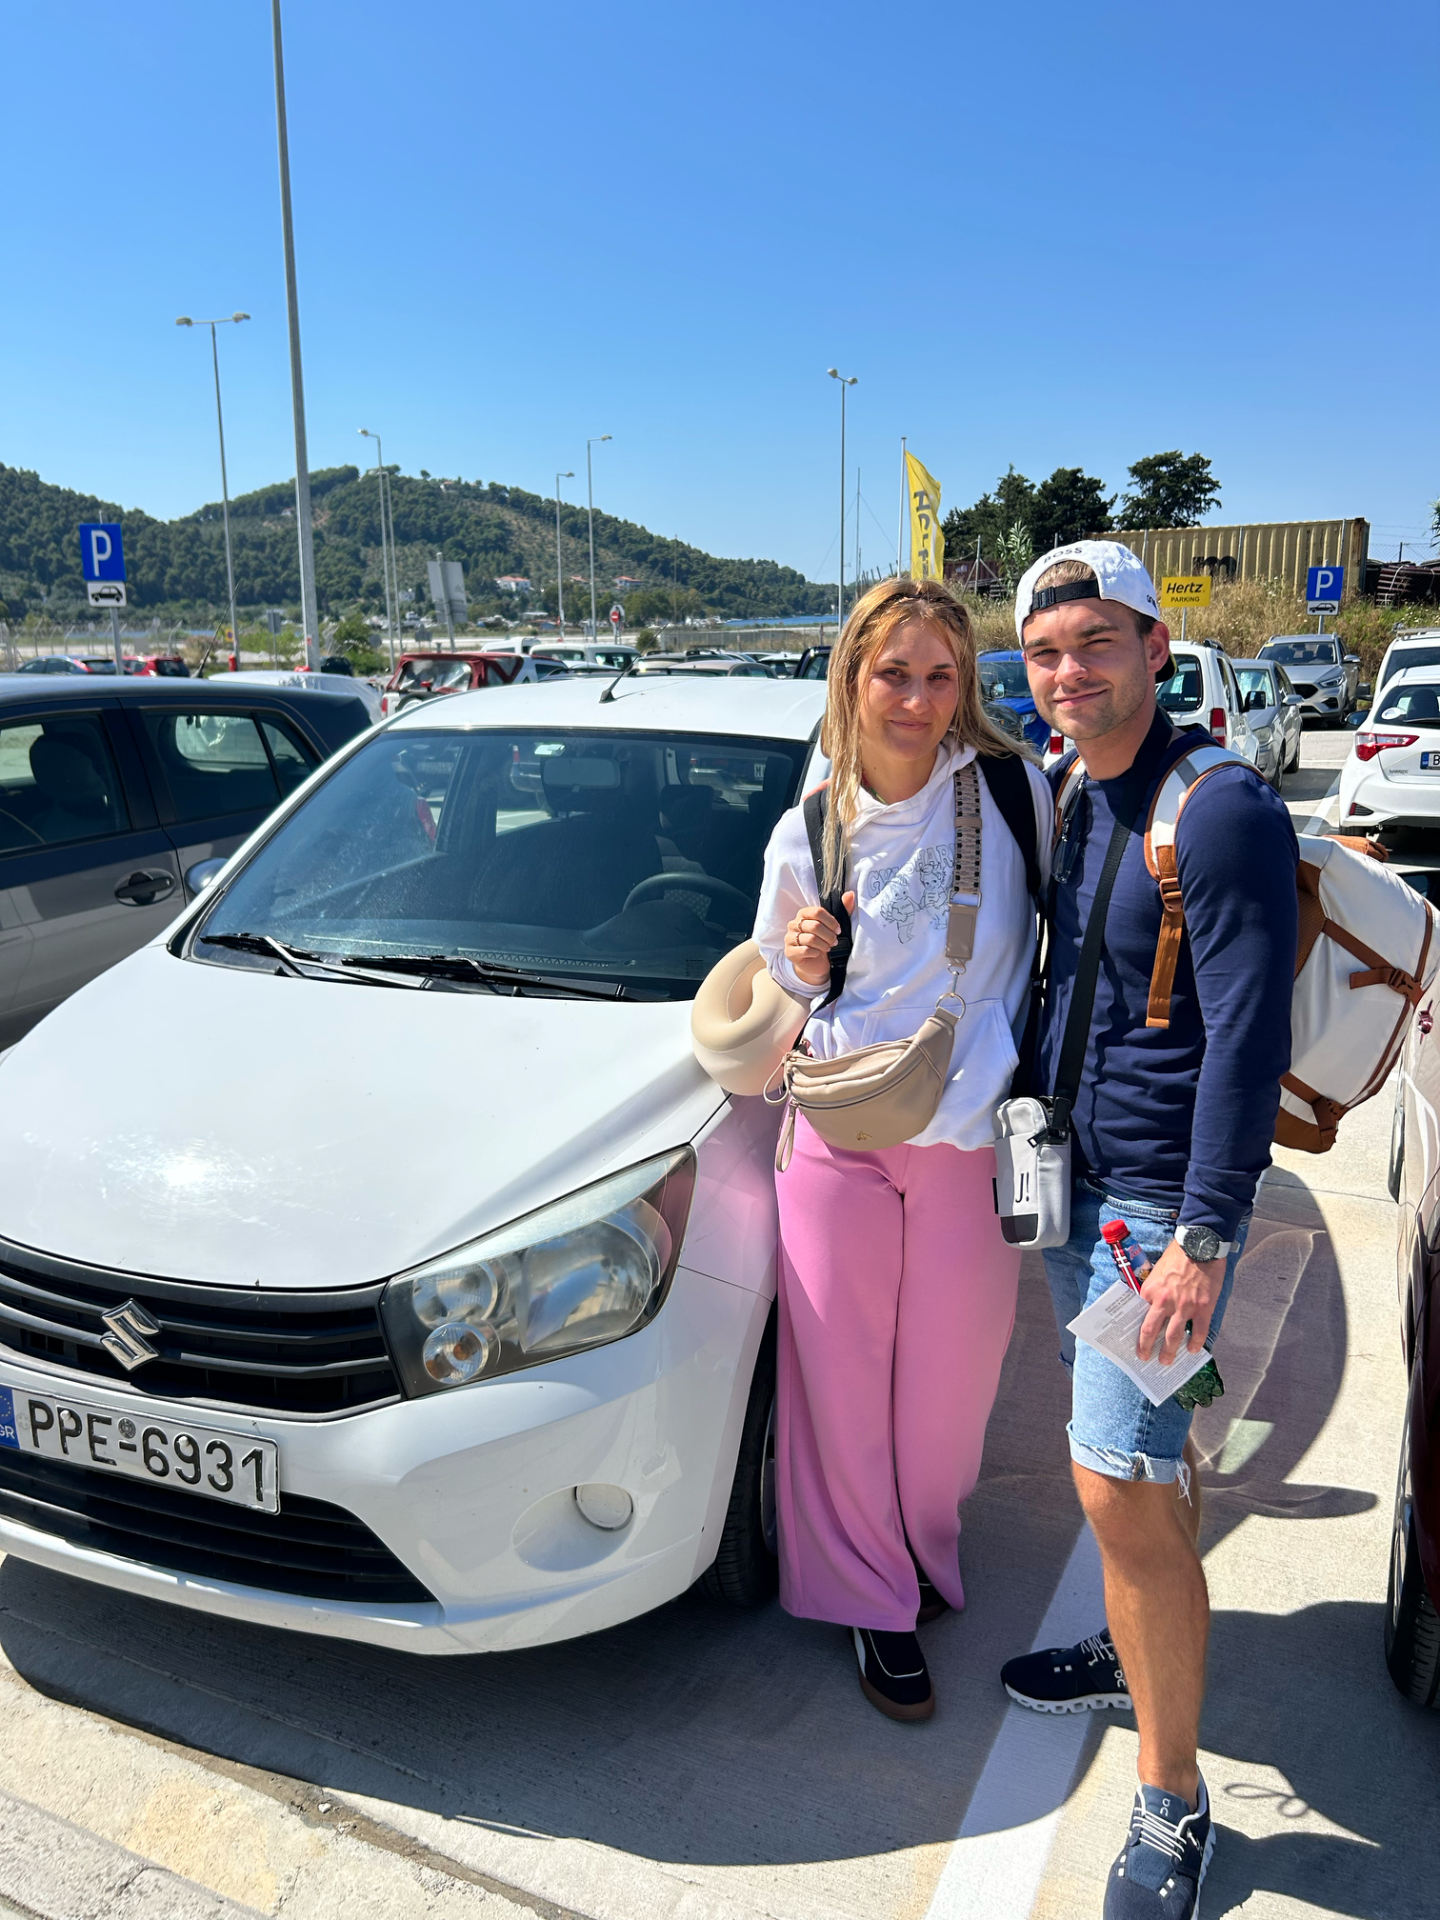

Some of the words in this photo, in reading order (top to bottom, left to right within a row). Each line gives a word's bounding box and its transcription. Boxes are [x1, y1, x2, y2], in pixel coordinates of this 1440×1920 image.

[91, 529, 112, 577] P
[1166, 582, 1204, 594] Hertz
[1315, 570, 1334, 598] P
[1015, 1171, 1030, 1203] J!
[28, 1399, 264, 1502] PPE-6931
